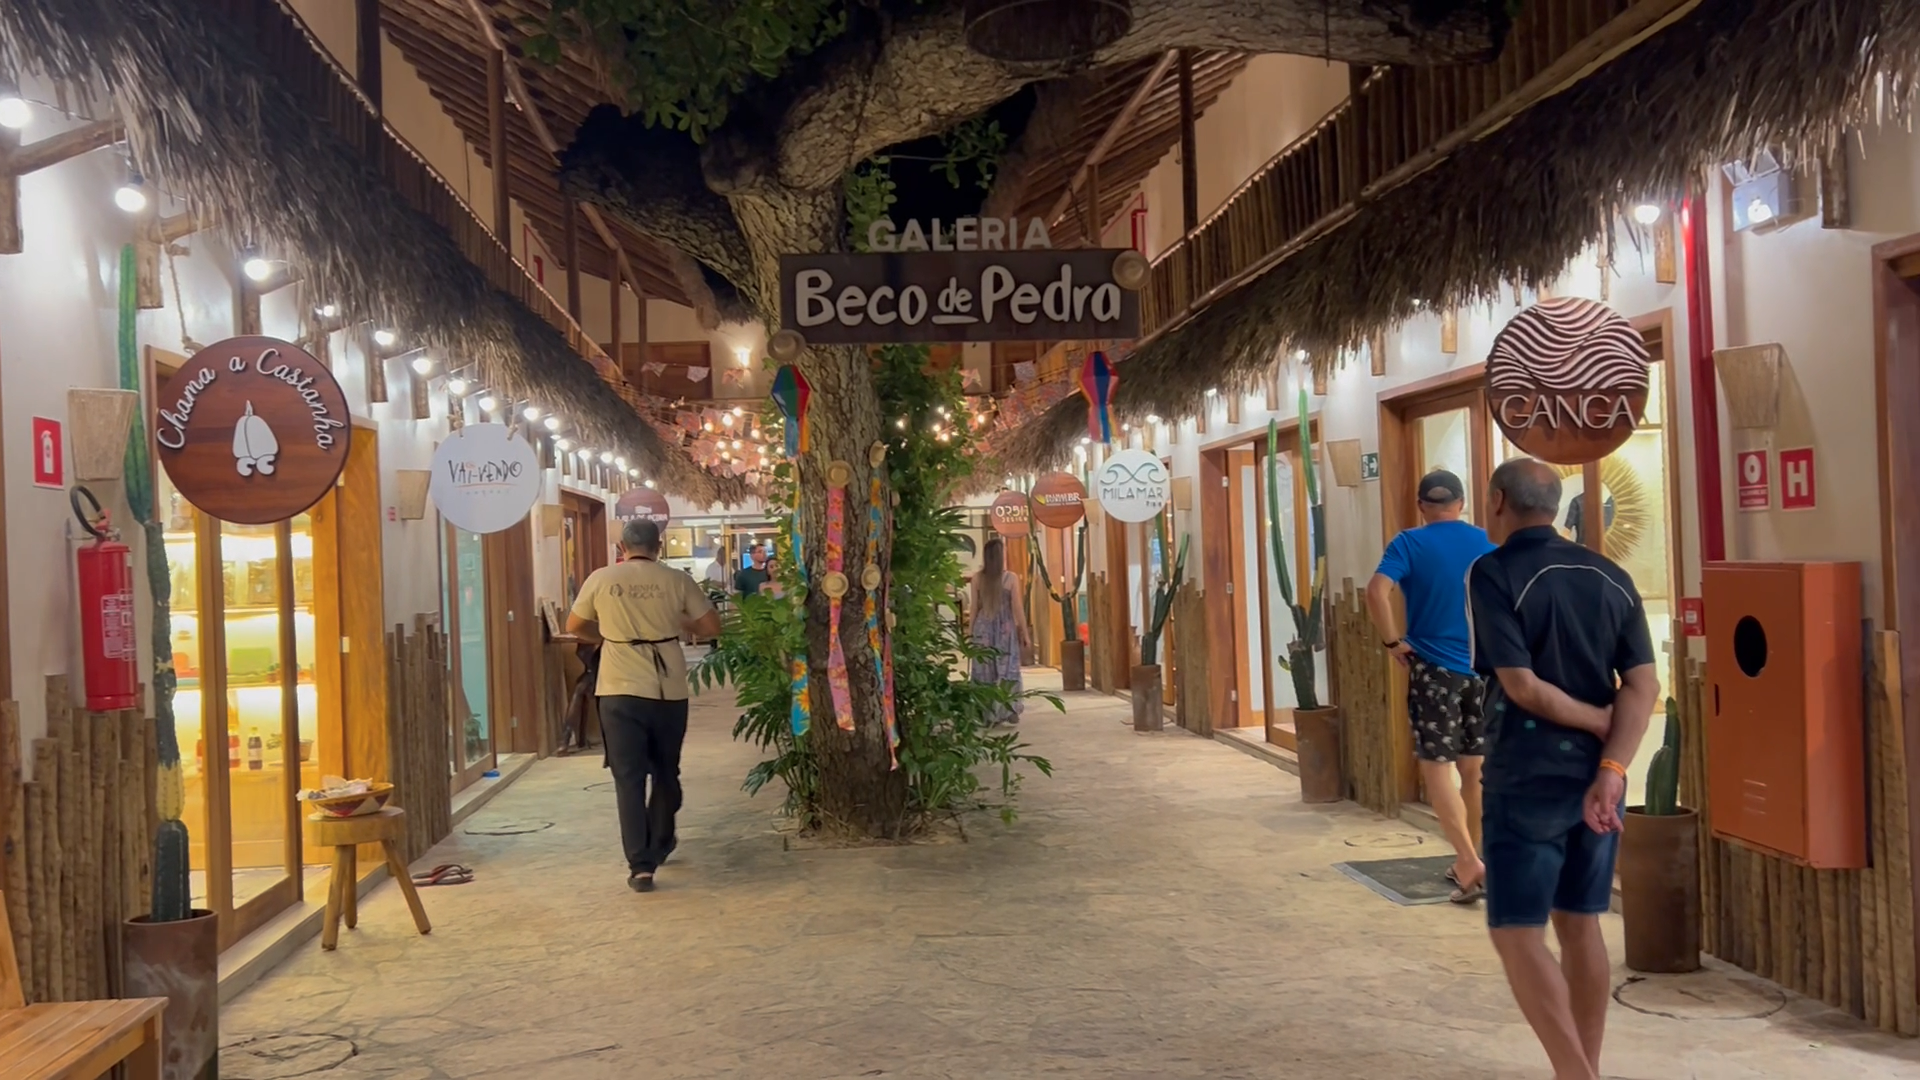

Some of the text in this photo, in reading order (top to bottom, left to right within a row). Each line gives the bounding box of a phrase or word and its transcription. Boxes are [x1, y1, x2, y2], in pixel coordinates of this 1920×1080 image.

[867, 217, 1051, 251] GALERIA
[795, 263, 1121, 327] Beco de Pedra
[156, 348, 345, 450] Chama a Castanha
[1501, 394, 1637, 430] GANGA
[1787, 460, 1809, 497] H
